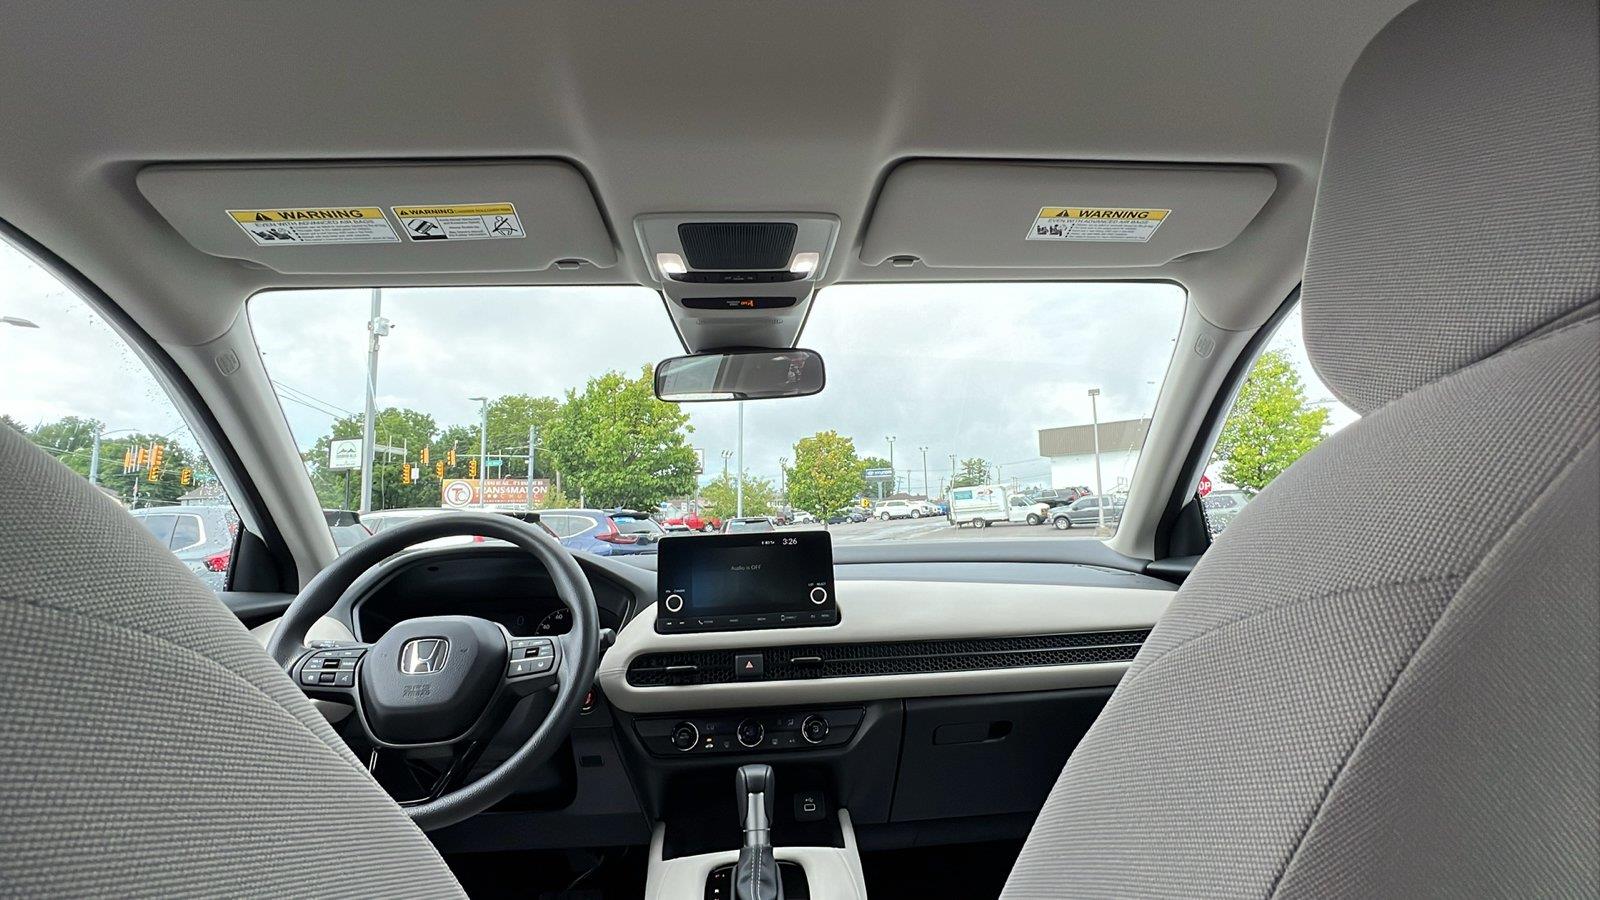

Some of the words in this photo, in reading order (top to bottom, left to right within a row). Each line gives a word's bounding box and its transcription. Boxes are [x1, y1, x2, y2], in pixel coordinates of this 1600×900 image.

[277, 210, 363, 220] WARNING
[1079, 210, 1149, 219] WARNING
[474, 486, 548, 494] TANS4MATON
[1198, 481, 1211, 490] OP
[782, 538, 798, 546] 3:26
